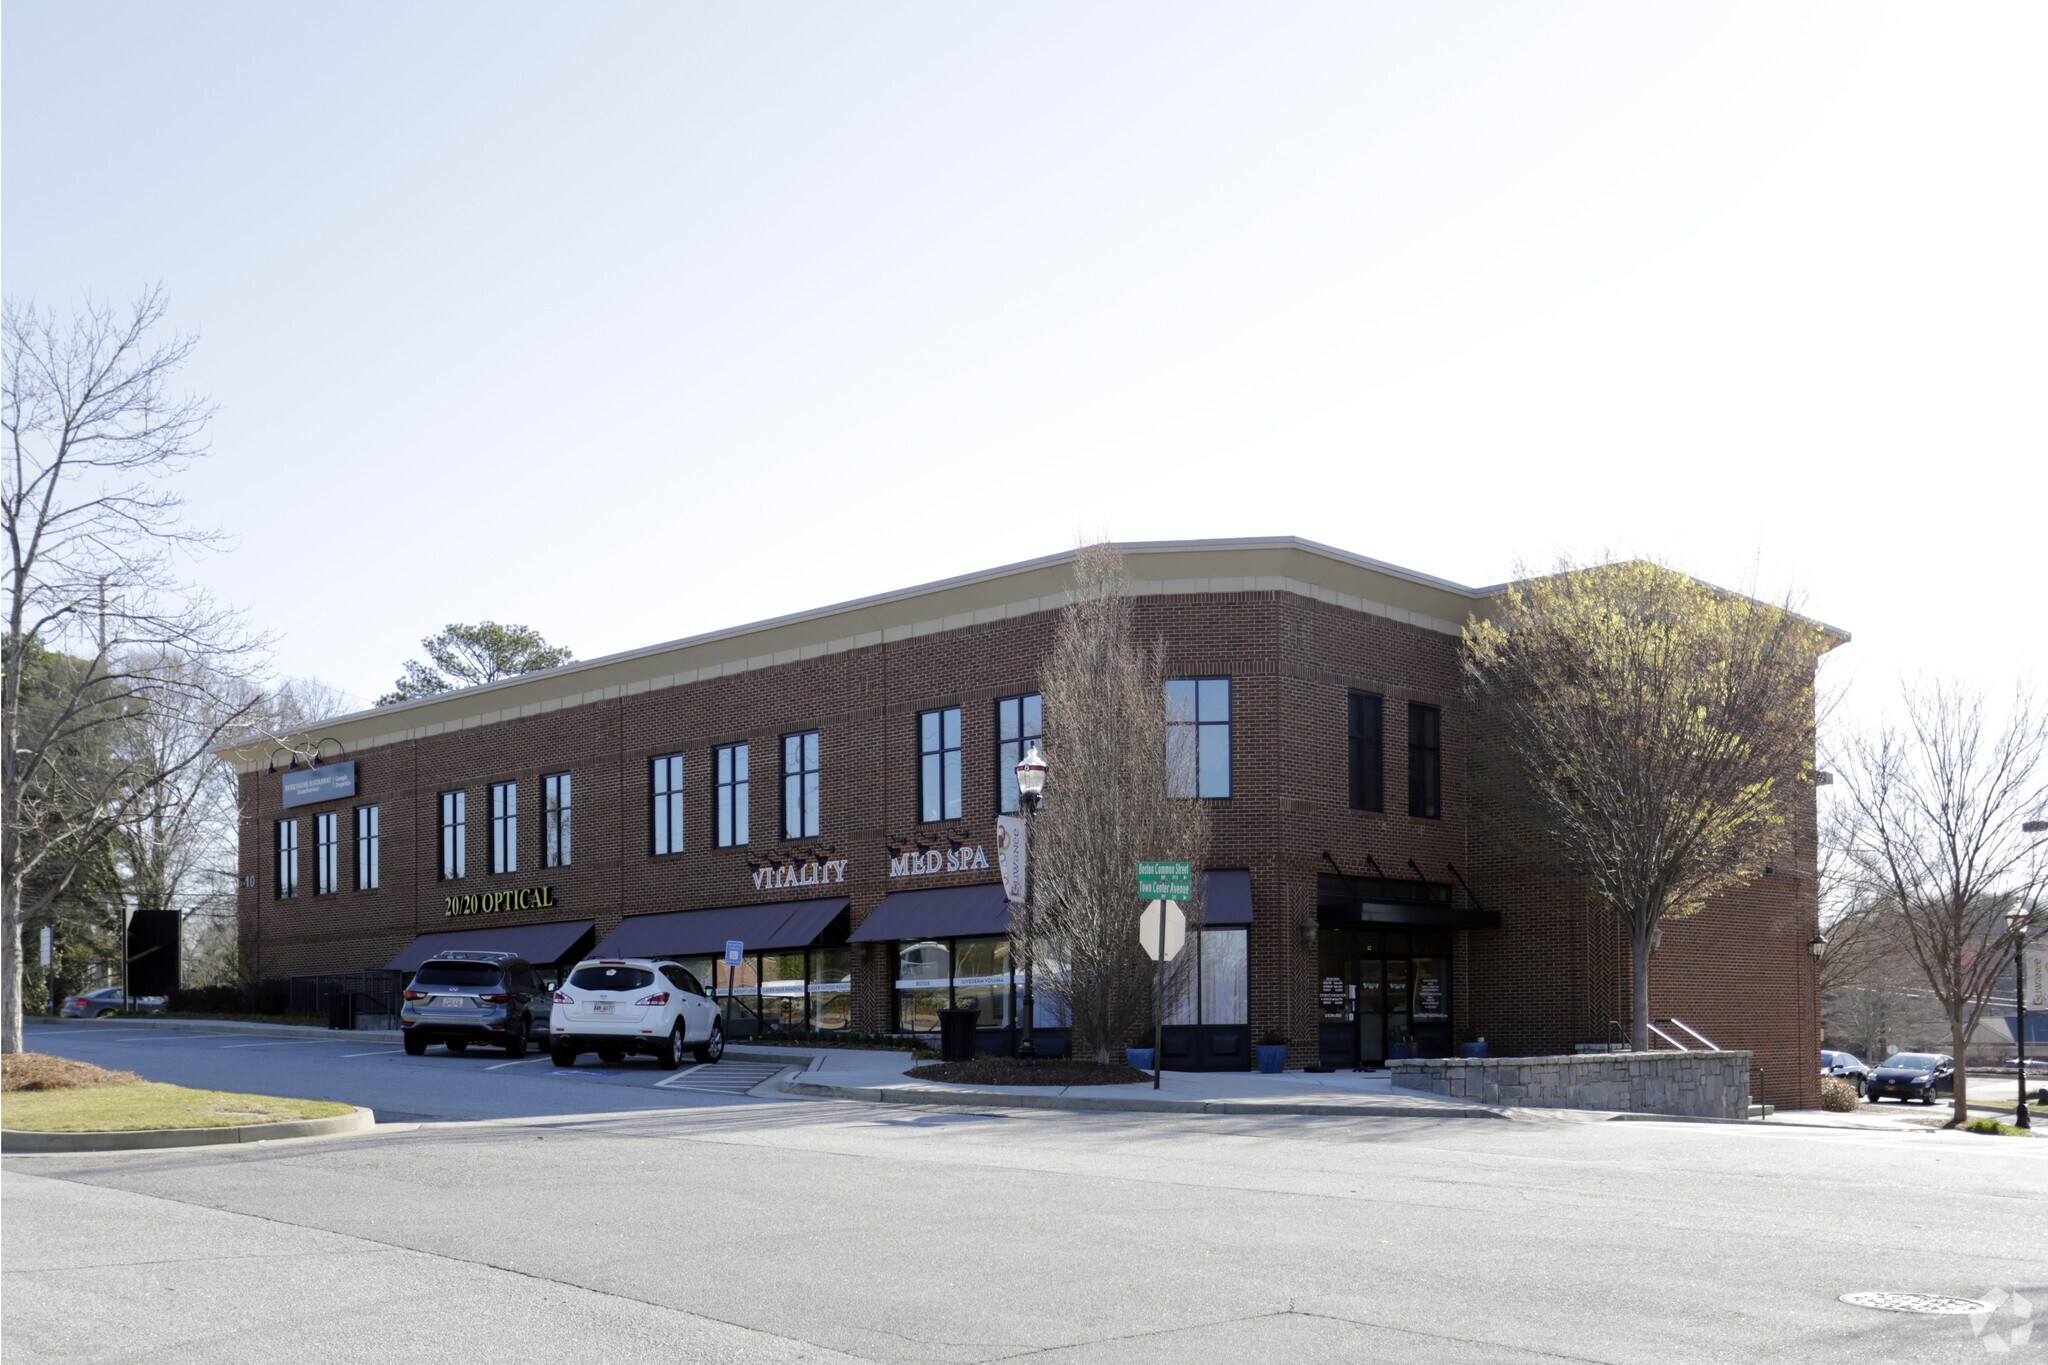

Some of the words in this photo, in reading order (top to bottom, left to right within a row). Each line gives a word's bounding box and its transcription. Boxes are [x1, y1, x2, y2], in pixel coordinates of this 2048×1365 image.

[752, 859, 848, 890] VITALITY
[890, 850, 942, 876] MED
[947, 845, 989, 871] SPA
[1138, 863, 1154, 874] Boston
[1155, 863, 1174, 874] Common
[1175, 863, 1189, 874] Street
[445, 894, 478, 916] 20/20
[481, 886, 552, 912] OPTICAL
[1140, 881, 1152, 892] Town
[1152, 881, 1170, 893] Center
[1170, 882, 1189, 894] Avenue
